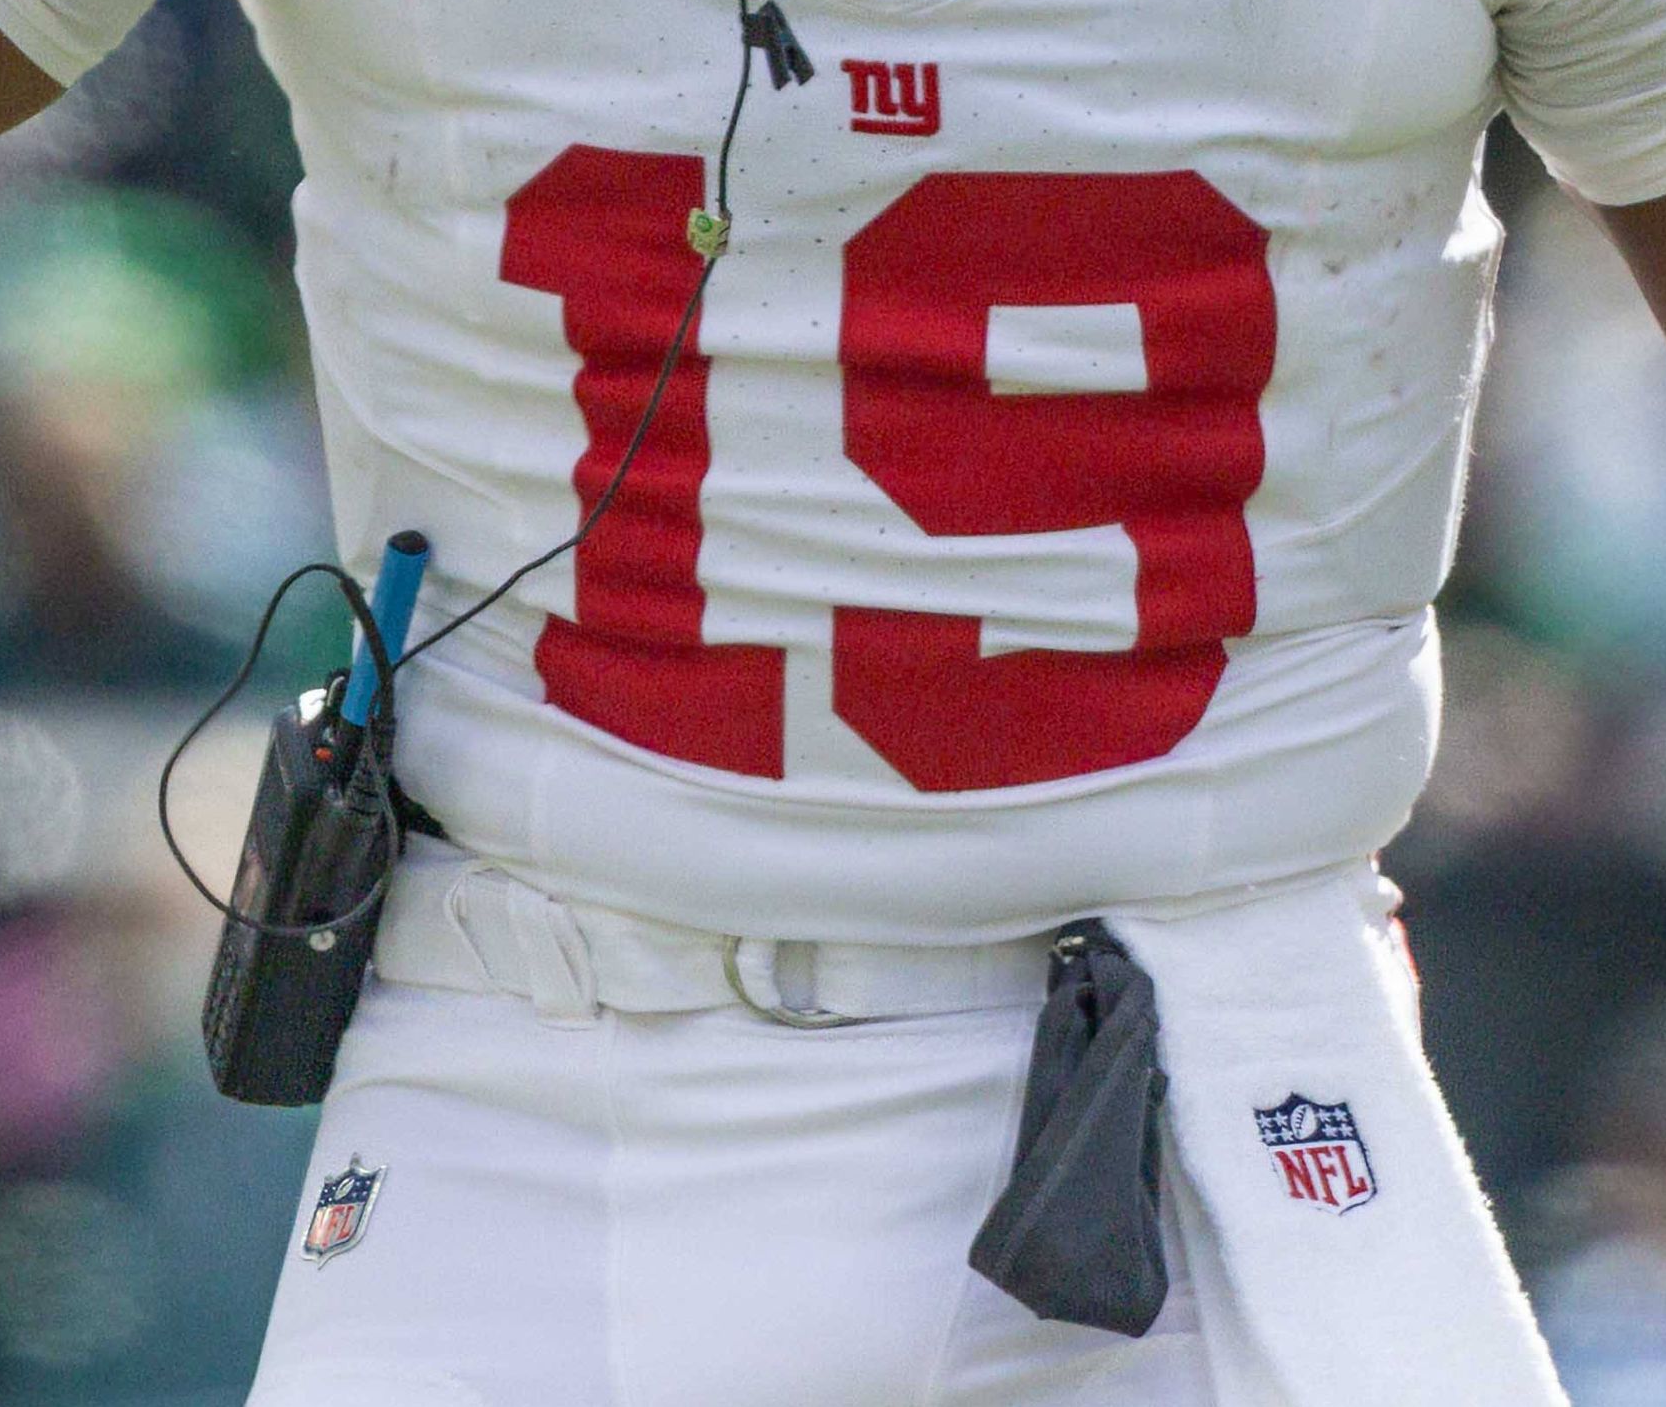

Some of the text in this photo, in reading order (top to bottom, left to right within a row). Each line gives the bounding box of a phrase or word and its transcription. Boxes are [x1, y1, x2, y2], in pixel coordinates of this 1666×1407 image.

[840, 58, 942, 137] ny
[499, 143, 1277, 793] 19
[1275, 1145, 1369, 1207] NFL
